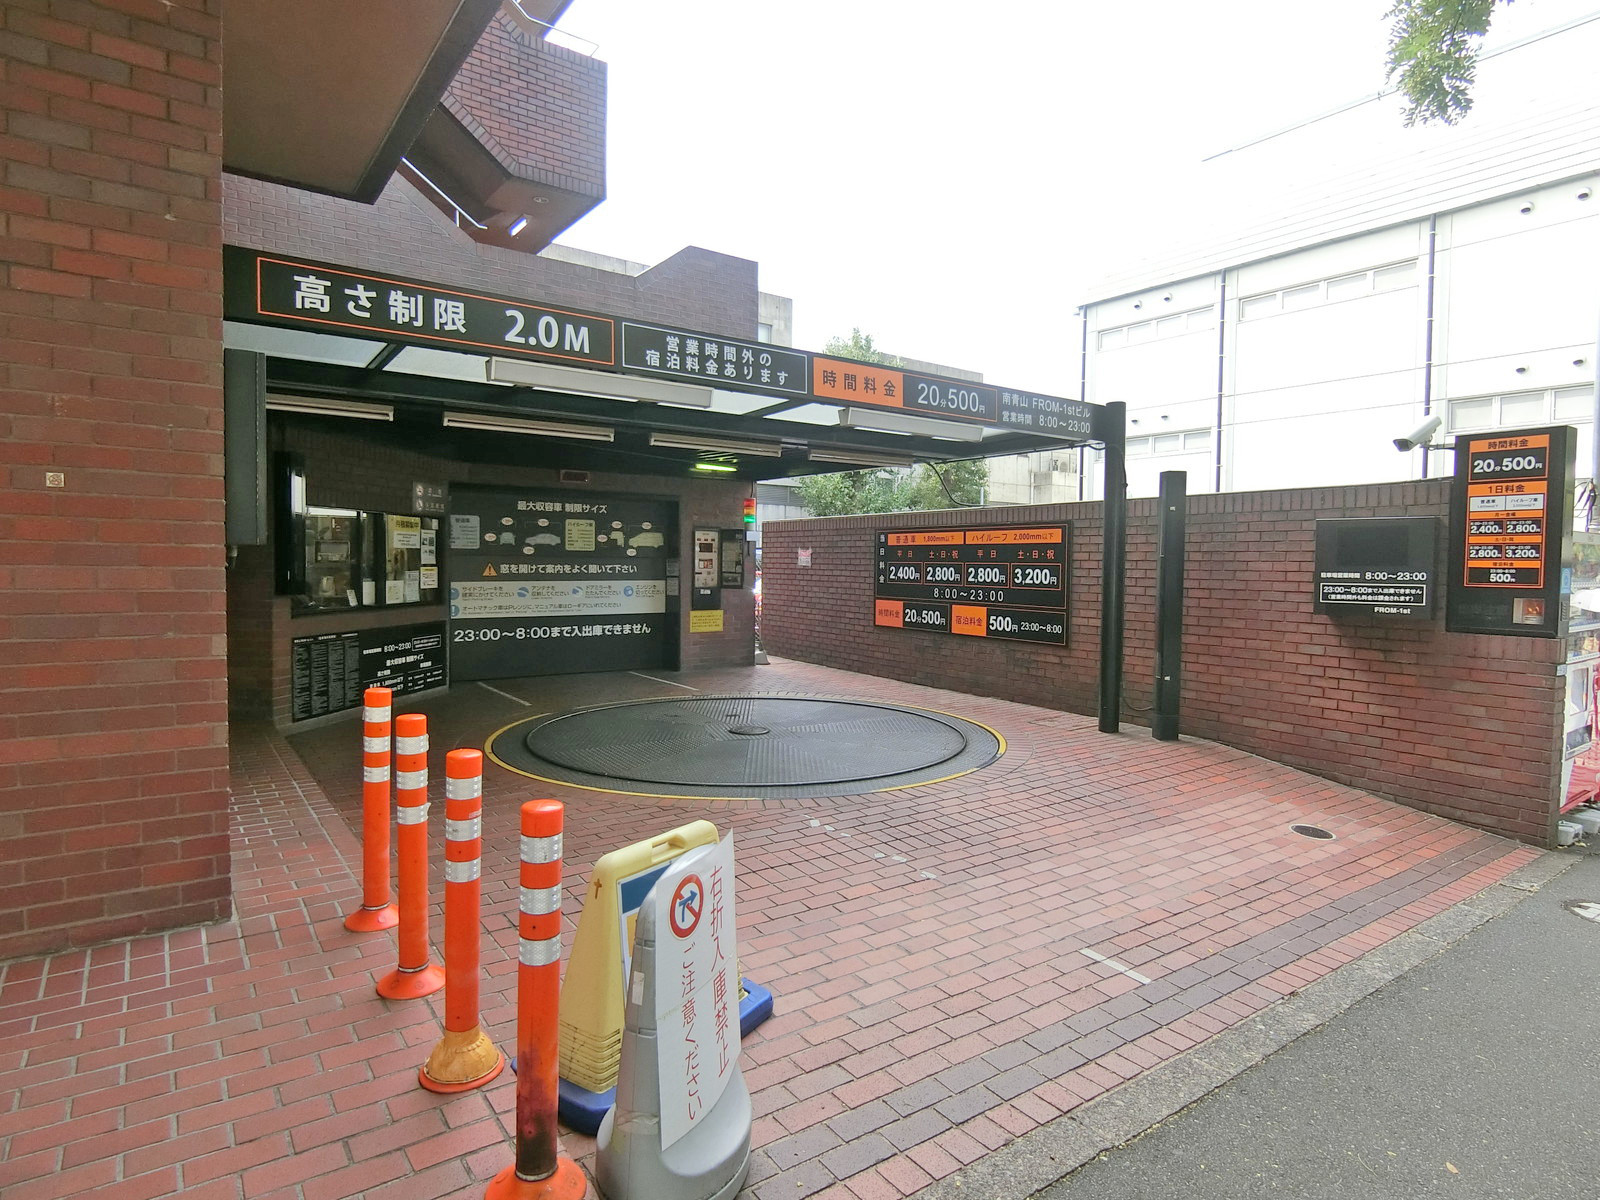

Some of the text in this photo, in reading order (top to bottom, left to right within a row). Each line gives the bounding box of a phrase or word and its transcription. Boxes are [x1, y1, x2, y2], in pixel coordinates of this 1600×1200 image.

[293, 274, 591, 354] 高さ制限 2.0M
[665, 335, 773, 368] 営業時間外の
[645, 349, 789, 386] 宿泊料金あります
[822, 369, 897, 398] 時間料金
[1001, 391, 1029, 408] 南青山
[1001, 410, 1033, 426] 営業時間
[1487, 439, 1529, 449] 時間料金
[1488, 484, 1526, 494] 1日料金
[565, 503, 608, 514] 制限サイズ
[895, 534, 917, 544] 普通車
[971, 533, 1008, 542] ハイルーフ
[889, 566, 920, 581] 2,400円
[926, 567, 961, 582] 2,800円
[967, 567, 1006, 584] 2,800円
[1014, 568, 1057, 585] 3,200円
[878, 608, 901, 619] 時間料金
[955, 615, 983, 627] 宿泊料金
[989, 615, 1019, 633] 500円
[710, 865, 730, 1078] 右折入庫禁止
[682, 941, 703, 1121] ご注意ください
